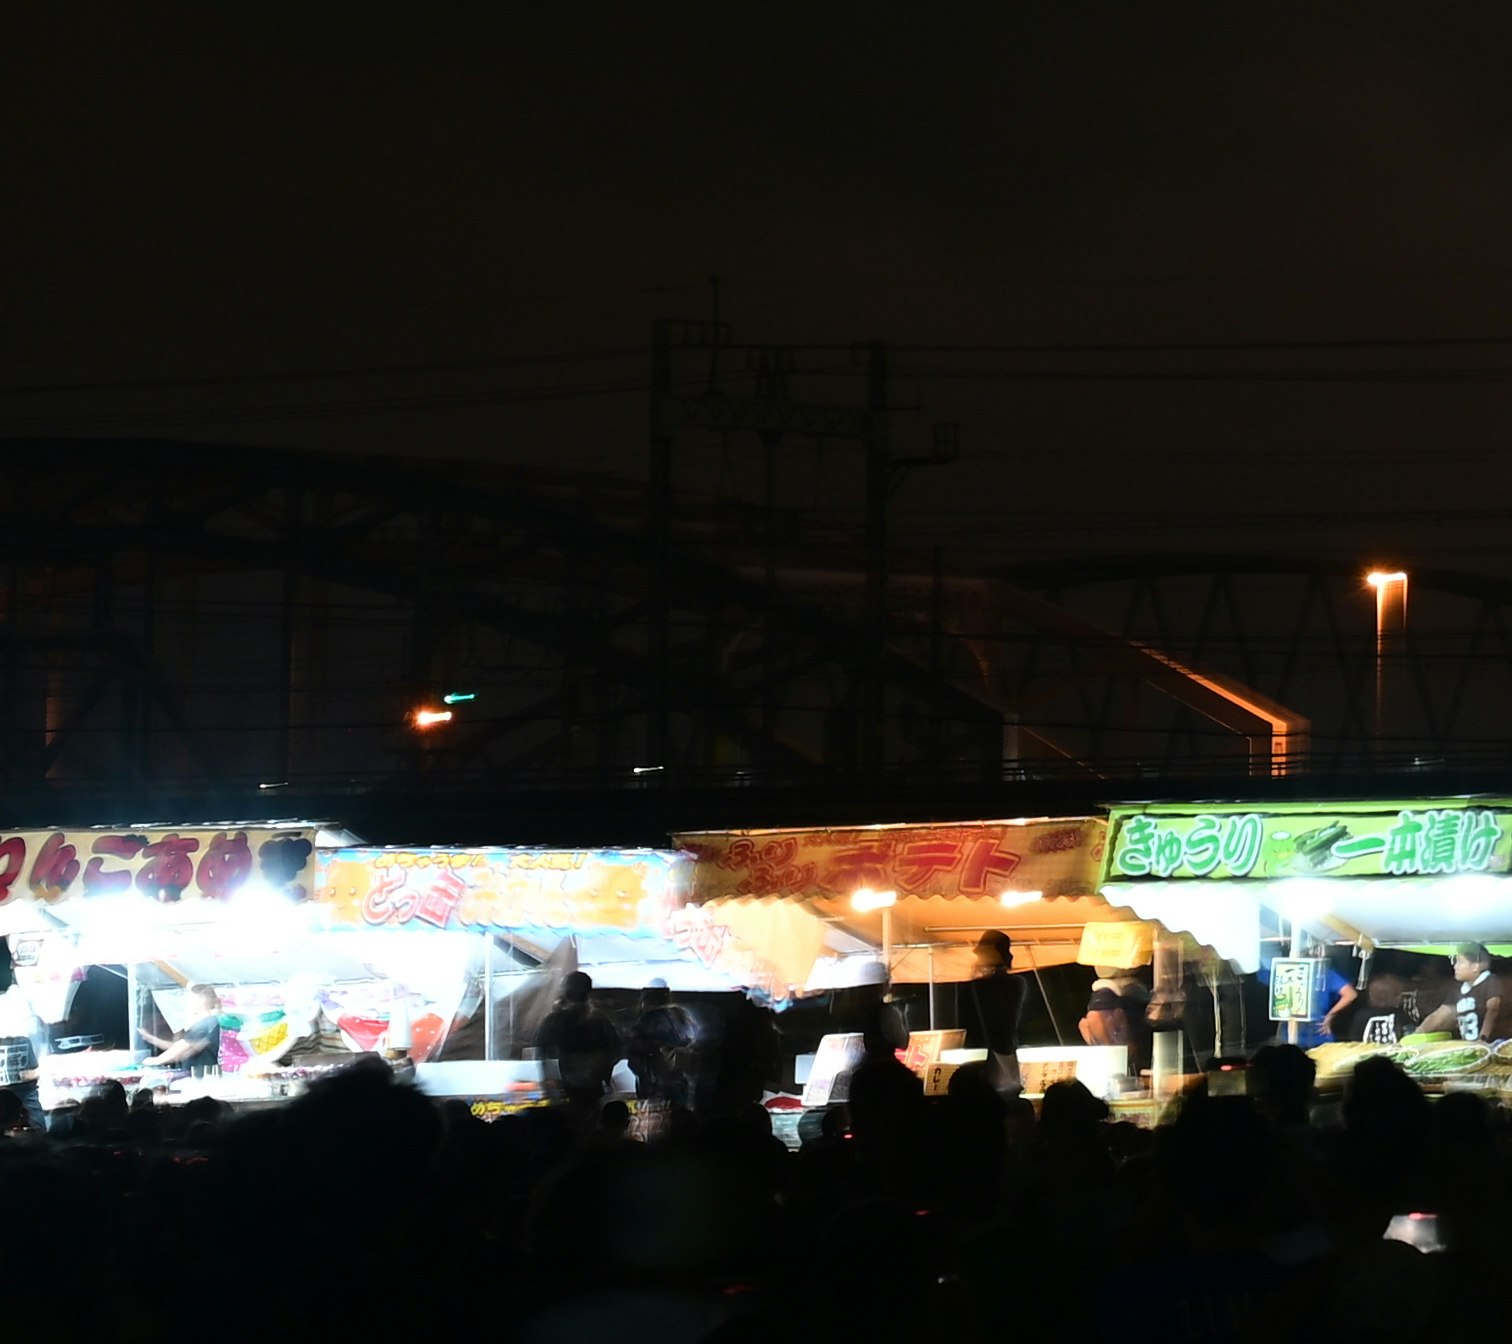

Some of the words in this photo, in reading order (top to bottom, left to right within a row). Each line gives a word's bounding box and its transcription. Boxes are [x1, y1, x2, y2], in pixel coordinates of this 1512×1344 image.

[1119, 814, 1264, 876] きゅうり
[1331, 809, 1503, 875] 一本漬け
